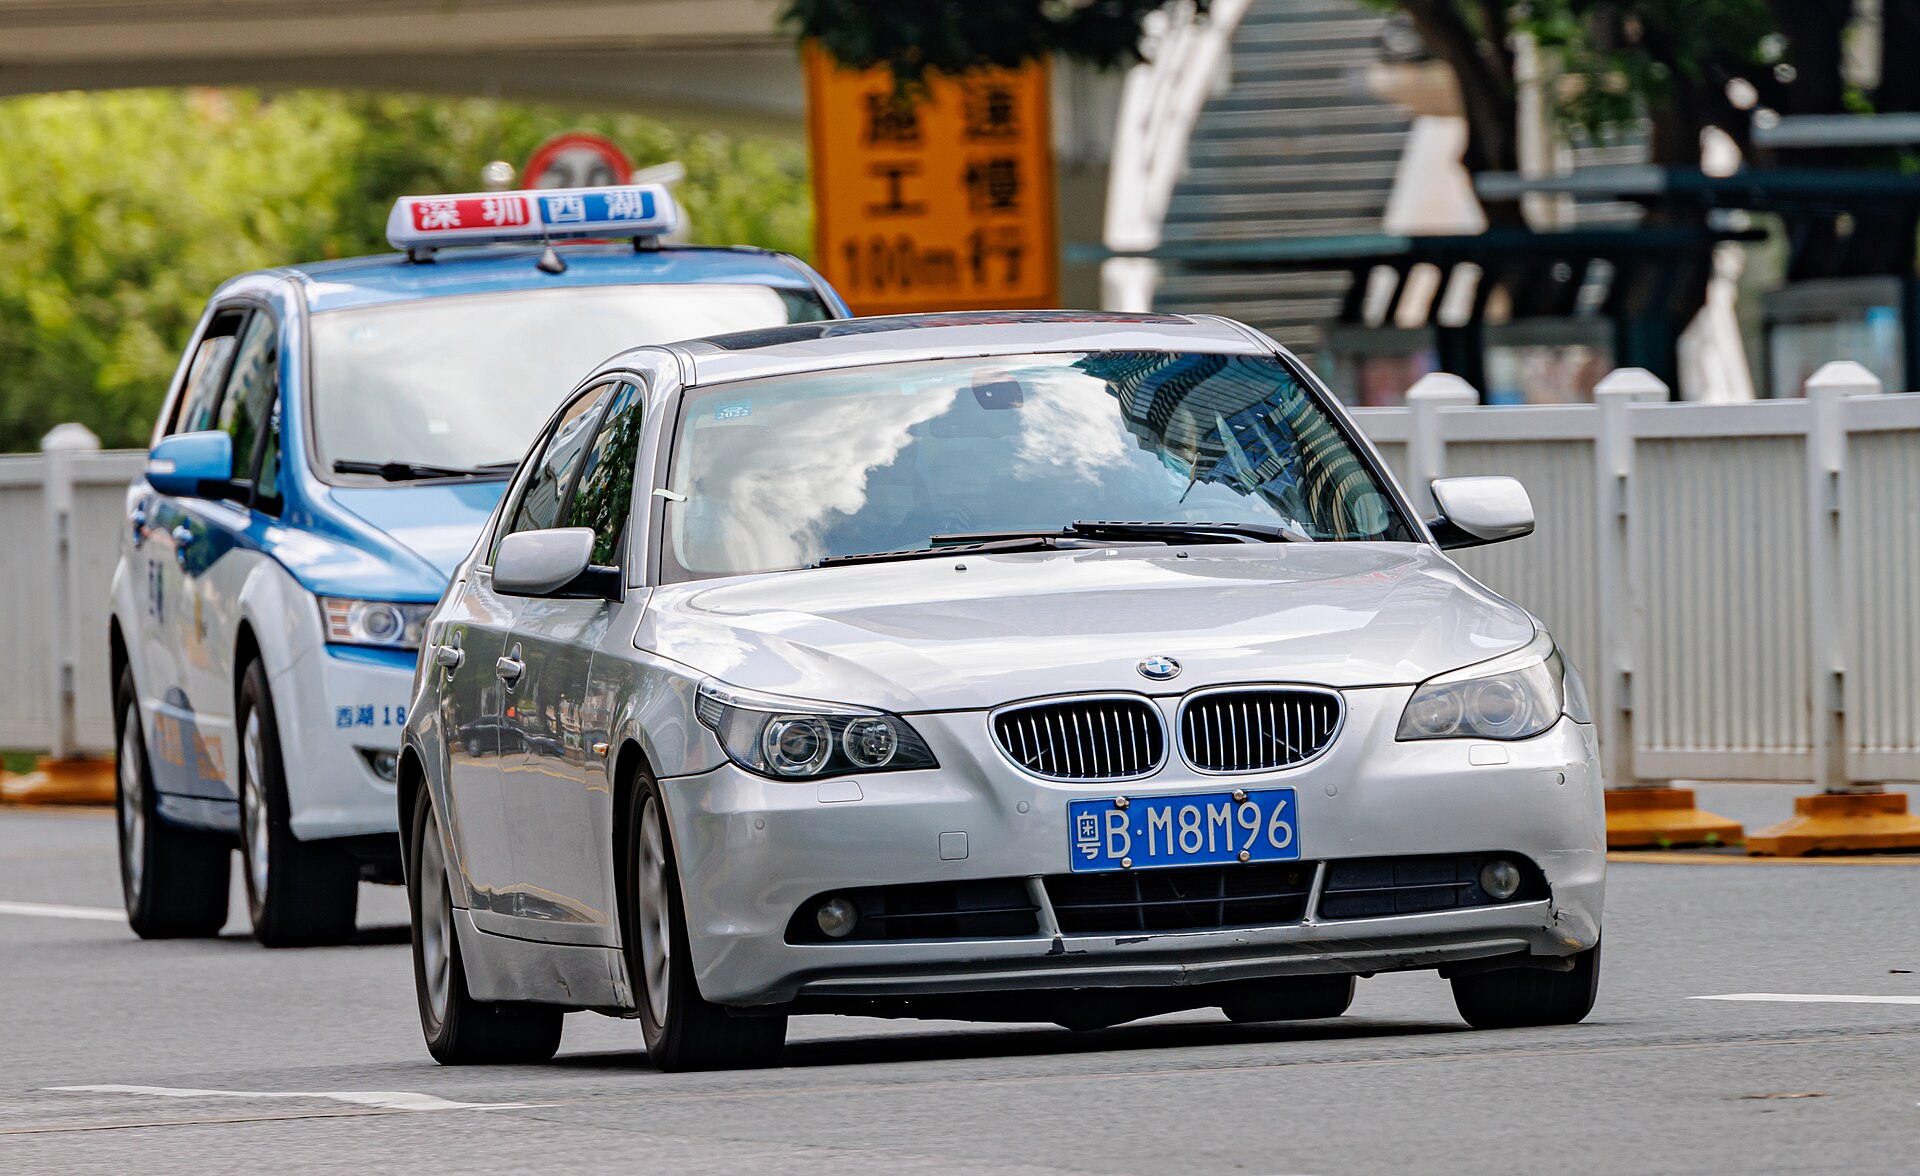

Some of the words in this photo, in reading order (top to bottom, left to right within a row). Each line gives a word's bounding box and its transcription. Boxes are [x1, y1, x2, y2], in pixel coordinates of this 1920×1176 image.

[418, 198, 524, 229] 深圳
[546, 191, 645, 223] 西湖
[717, 408, 749, 420] 2022
[336, 704, 374, 728] 西湖
